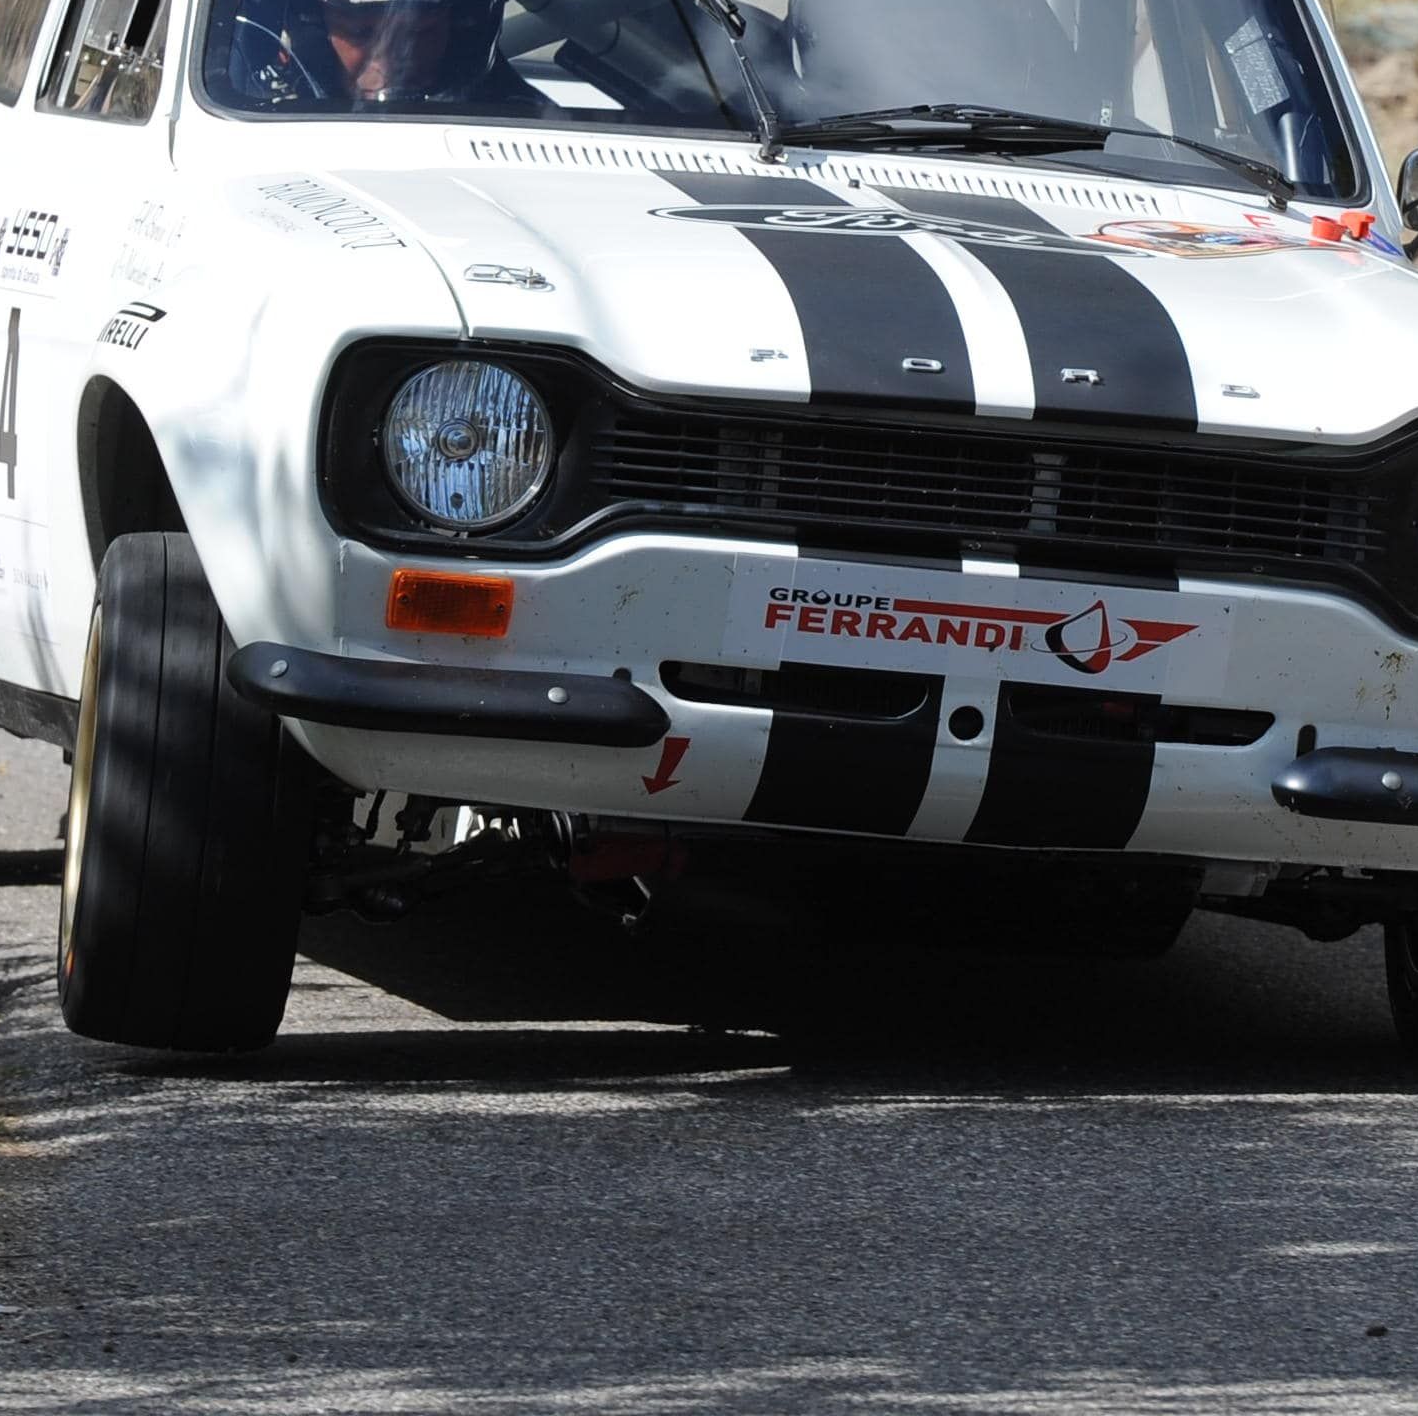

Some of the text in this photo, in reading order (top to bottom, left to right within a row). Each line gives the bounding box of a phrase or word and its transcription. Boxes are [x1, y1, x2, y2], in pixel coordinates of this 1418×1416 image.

[764, 209, 1045, 245] Ford
[97, 301, 167, 351] PIRELLI
[769, 586, 892, 612] GROUPE
[764, 602, 1024, 651] FERRANDI
